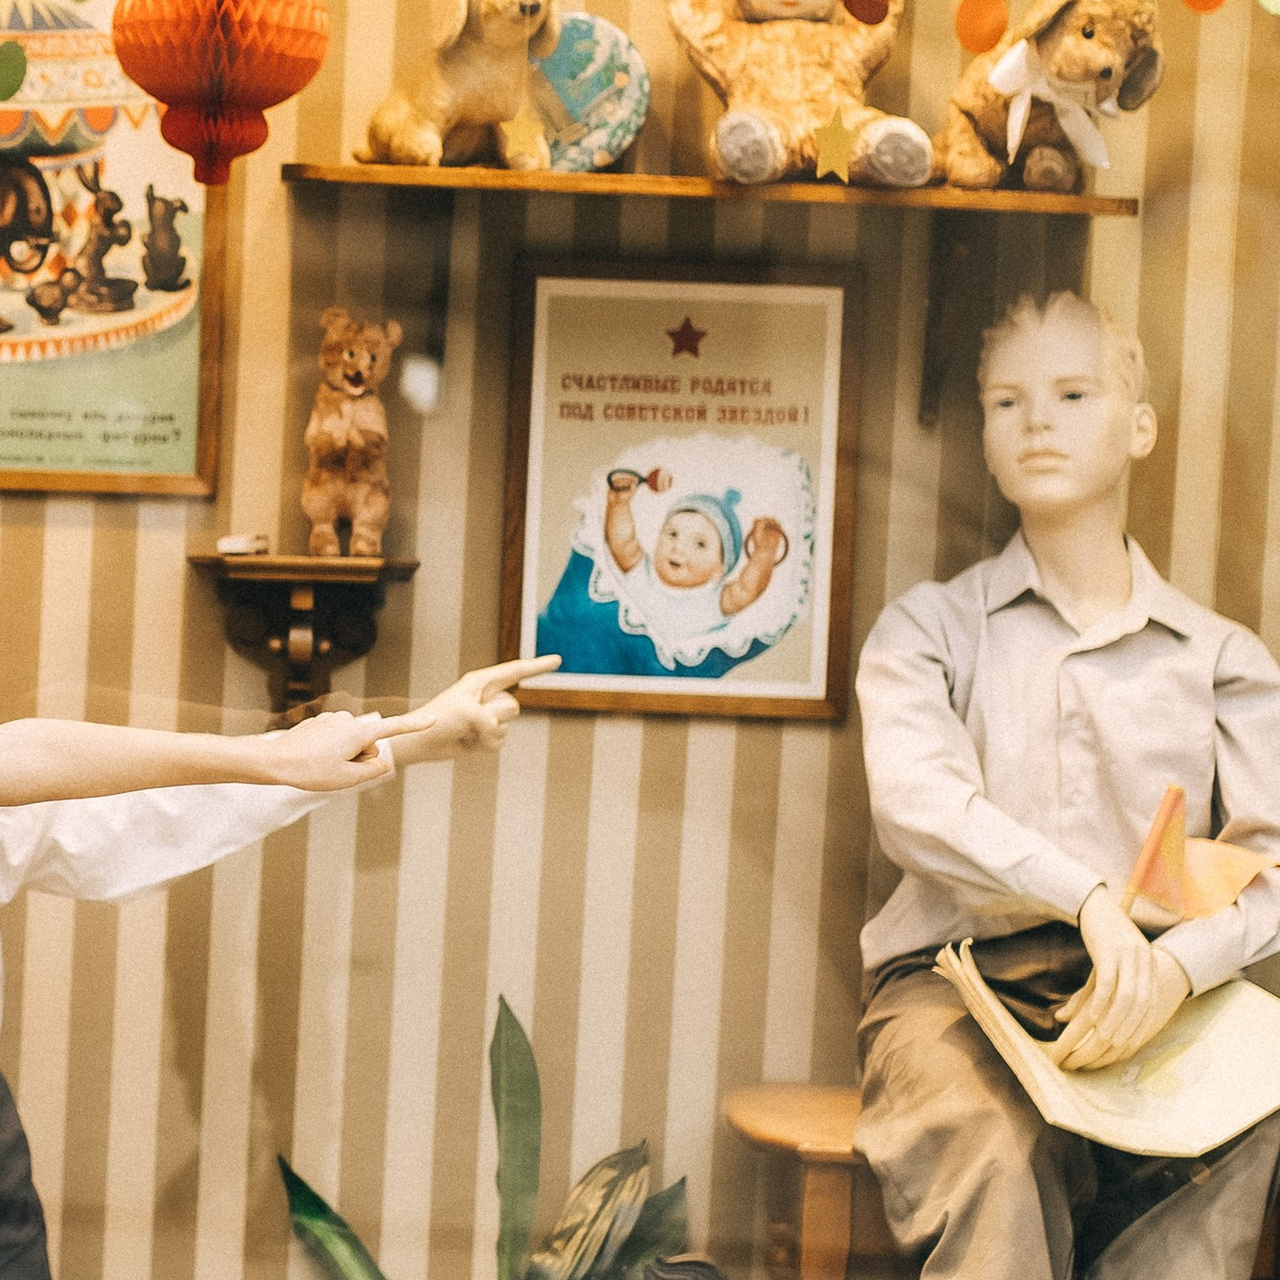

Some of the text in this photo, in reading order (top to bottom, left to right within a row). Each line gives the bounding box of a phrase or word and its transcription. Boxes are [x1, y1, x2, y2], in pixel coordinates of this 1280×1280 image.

[560, 373, 772, 397] СЧАСТЛИВЫЕ РОДЯТСЯ
[559, 401, 594, 422] ПОД
[602, 402, 708, 423] СОВЕТСКОЙ
